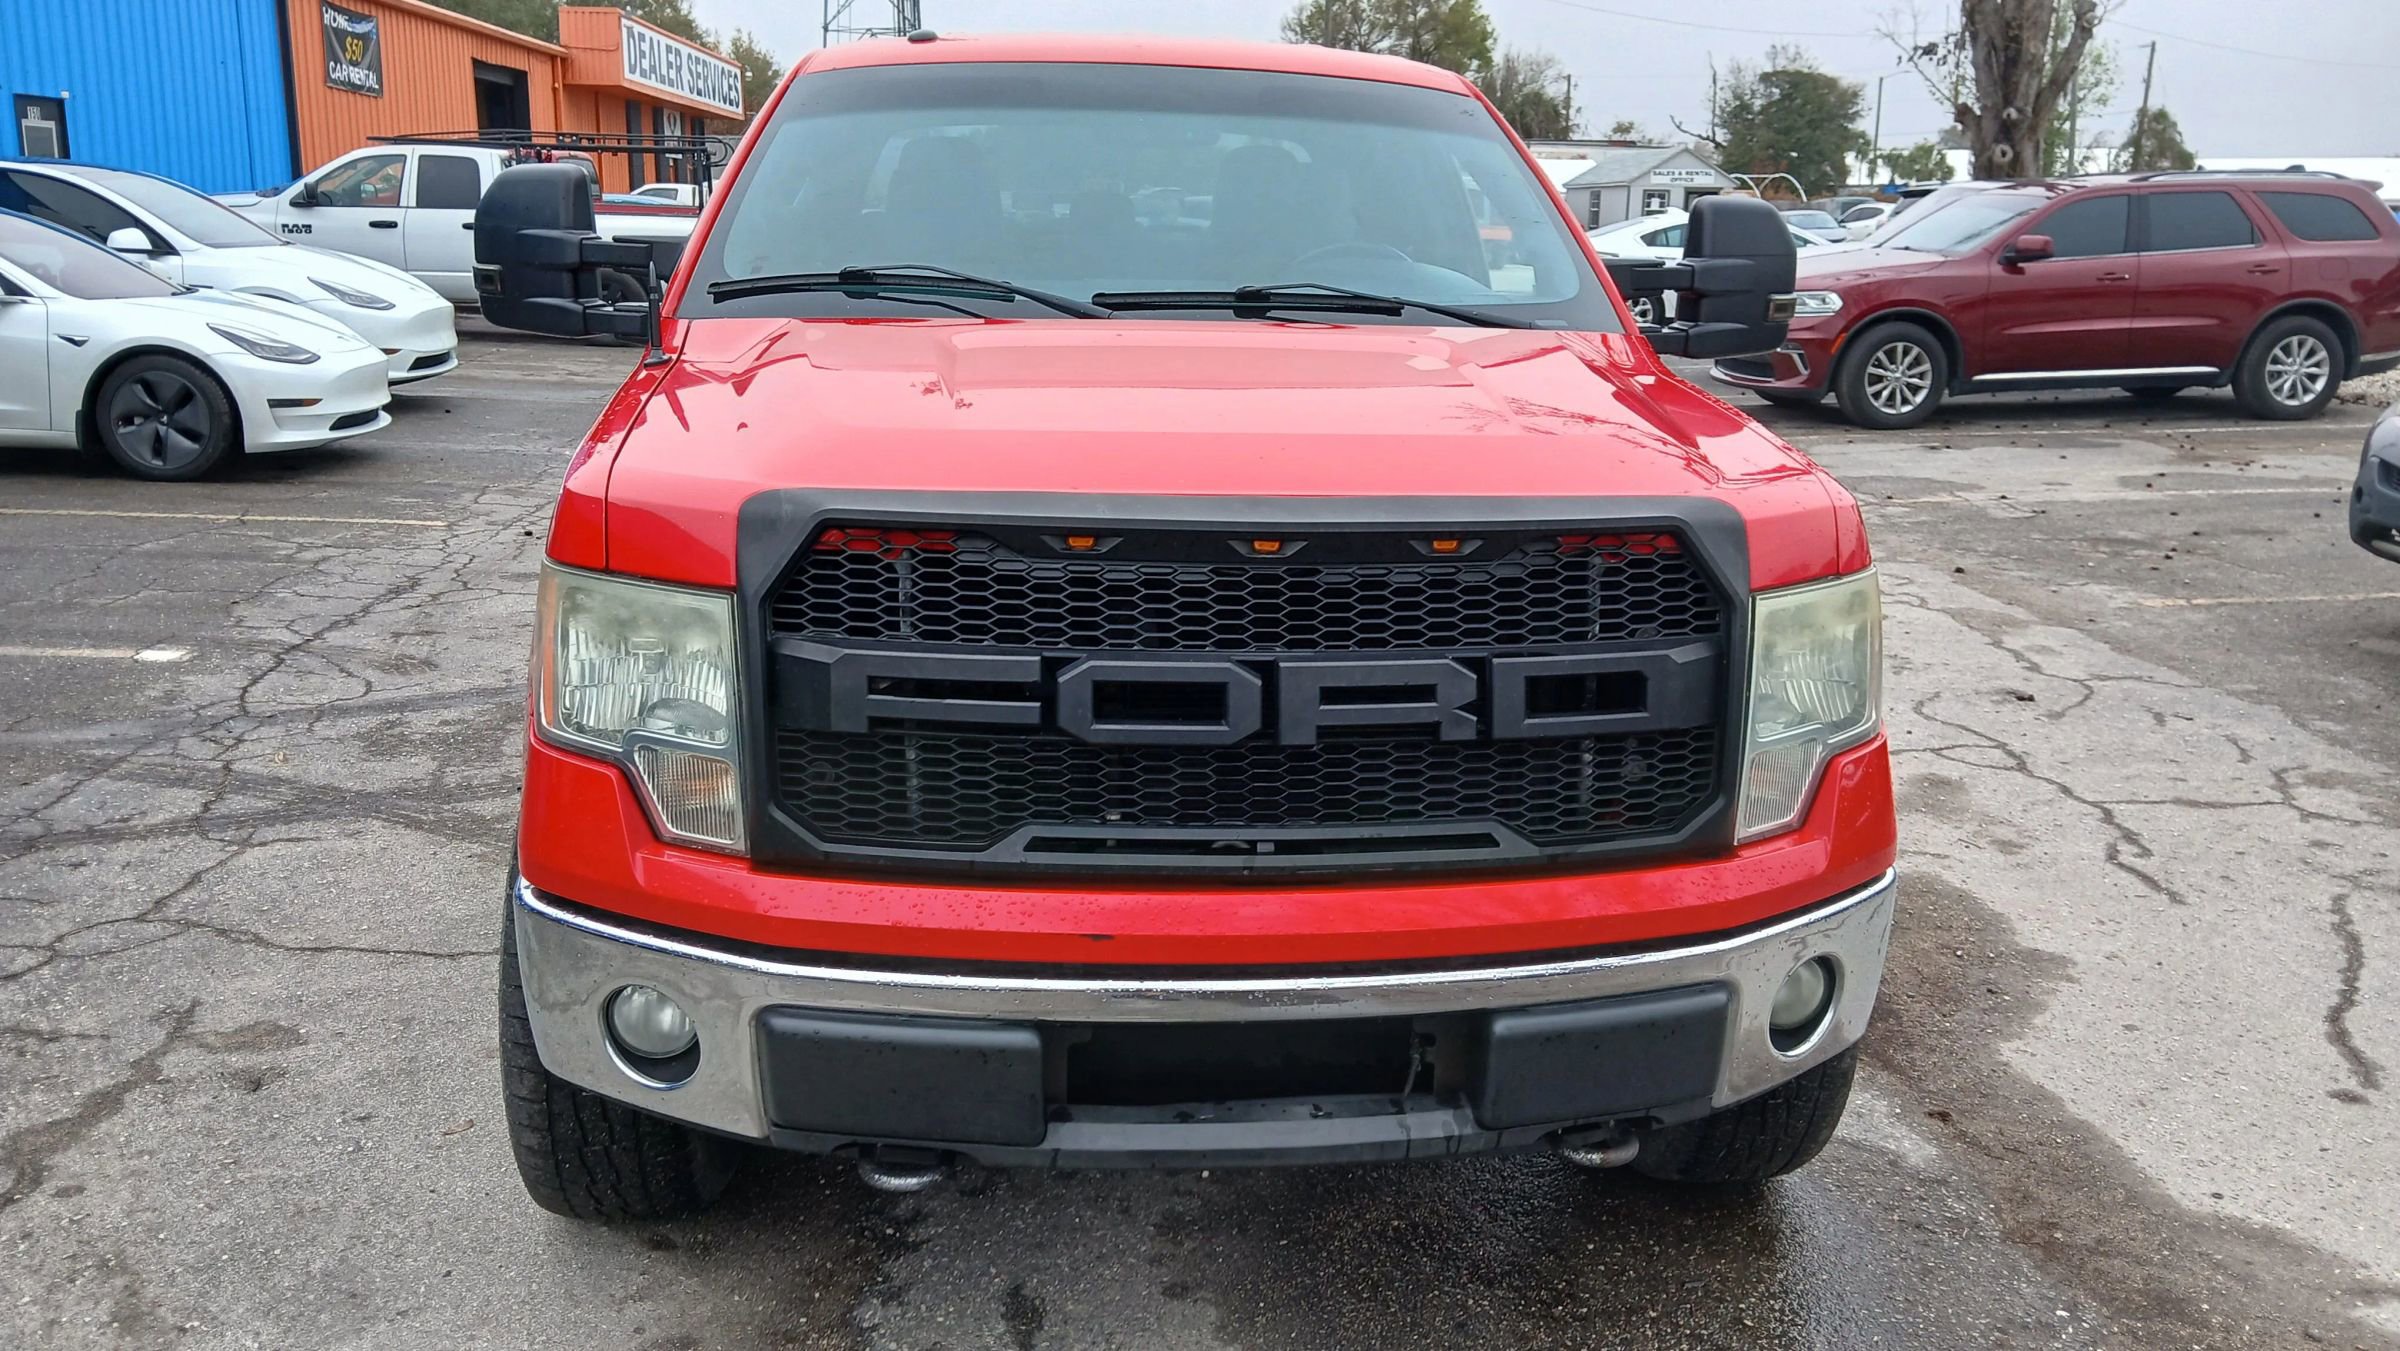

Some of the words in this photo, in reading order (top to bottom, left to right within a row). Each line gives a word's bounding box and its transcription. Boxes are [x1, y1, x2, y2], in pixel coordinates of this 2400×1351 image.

[329, 61, 349, 82] CAR
[349, 66, 379, 88] RENTAL
[345, 35, 363, 62] $50
[626, 26, 684, 91] DEALER
[687, 52, 740, 109] SERVICES
[815, 645, 1690, 744] FORD
